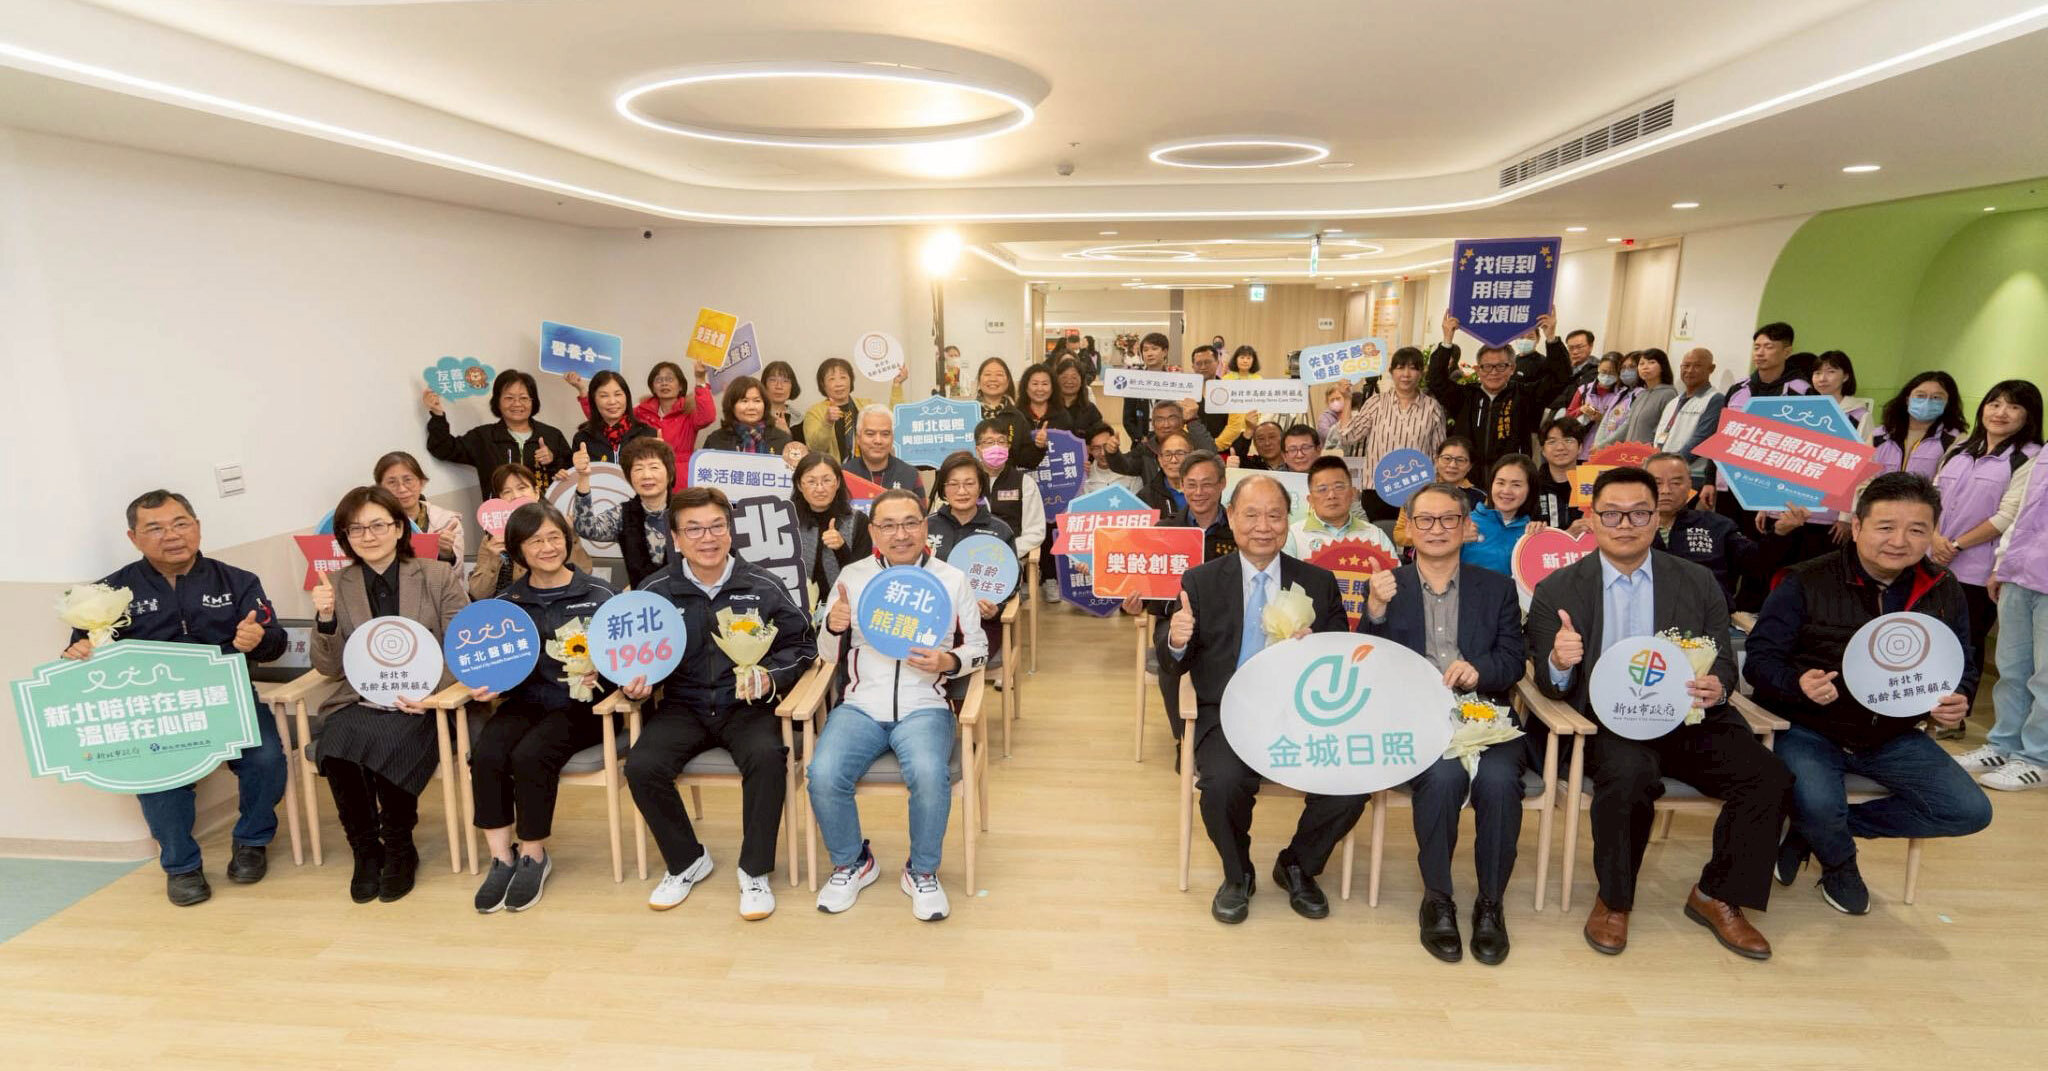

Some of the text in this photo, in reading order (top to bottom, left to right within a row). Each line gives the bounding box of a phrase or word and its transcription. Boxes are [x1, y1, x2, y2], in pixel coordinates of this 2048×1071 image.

[1474, 254, 1537, 275] 找得到
[1471, 280, 1534, 299] 用得著
[1469, 305, 1531, 324] 沒煩惱
[551, 340, 612, 363] 醫養合一
[436, 369, 464, 381] 友善
[440, 381, 465, 394] 天使
[1721, 420, 1862, 471] 新北長照不停歇
[1725, 439, 1828, 480] 溫暖到你家
[697, 467, 792, 489] 樂活健腦巴士
[969, 563, 999, 577] 高齡
[1105, 552, 1190, 576] 樂齡創藝
[202, 593, 233, 605] KMT
[884, 580, 936, 614] 新北
[607, 605, 663, 641] 新北
[868, 608, 920, 641] 熊讚
[458, 638, 530, 667] 新北醫動養
[605, 637, 673, 672] 1966
[380, 670, 409, 680] 新北市
[1887, 672, 1924, 688] 新北市
[1866, 679, 1952, 705] 高齡長期照顧處
[43, 685, 230, 729] 新北陪伴在身邊
[1612, 702, 1675, 717] 新北市政府
[76, 711, 209, 748] 溫暖在心間
[1267, 732, 1418, 769] 金城日照
